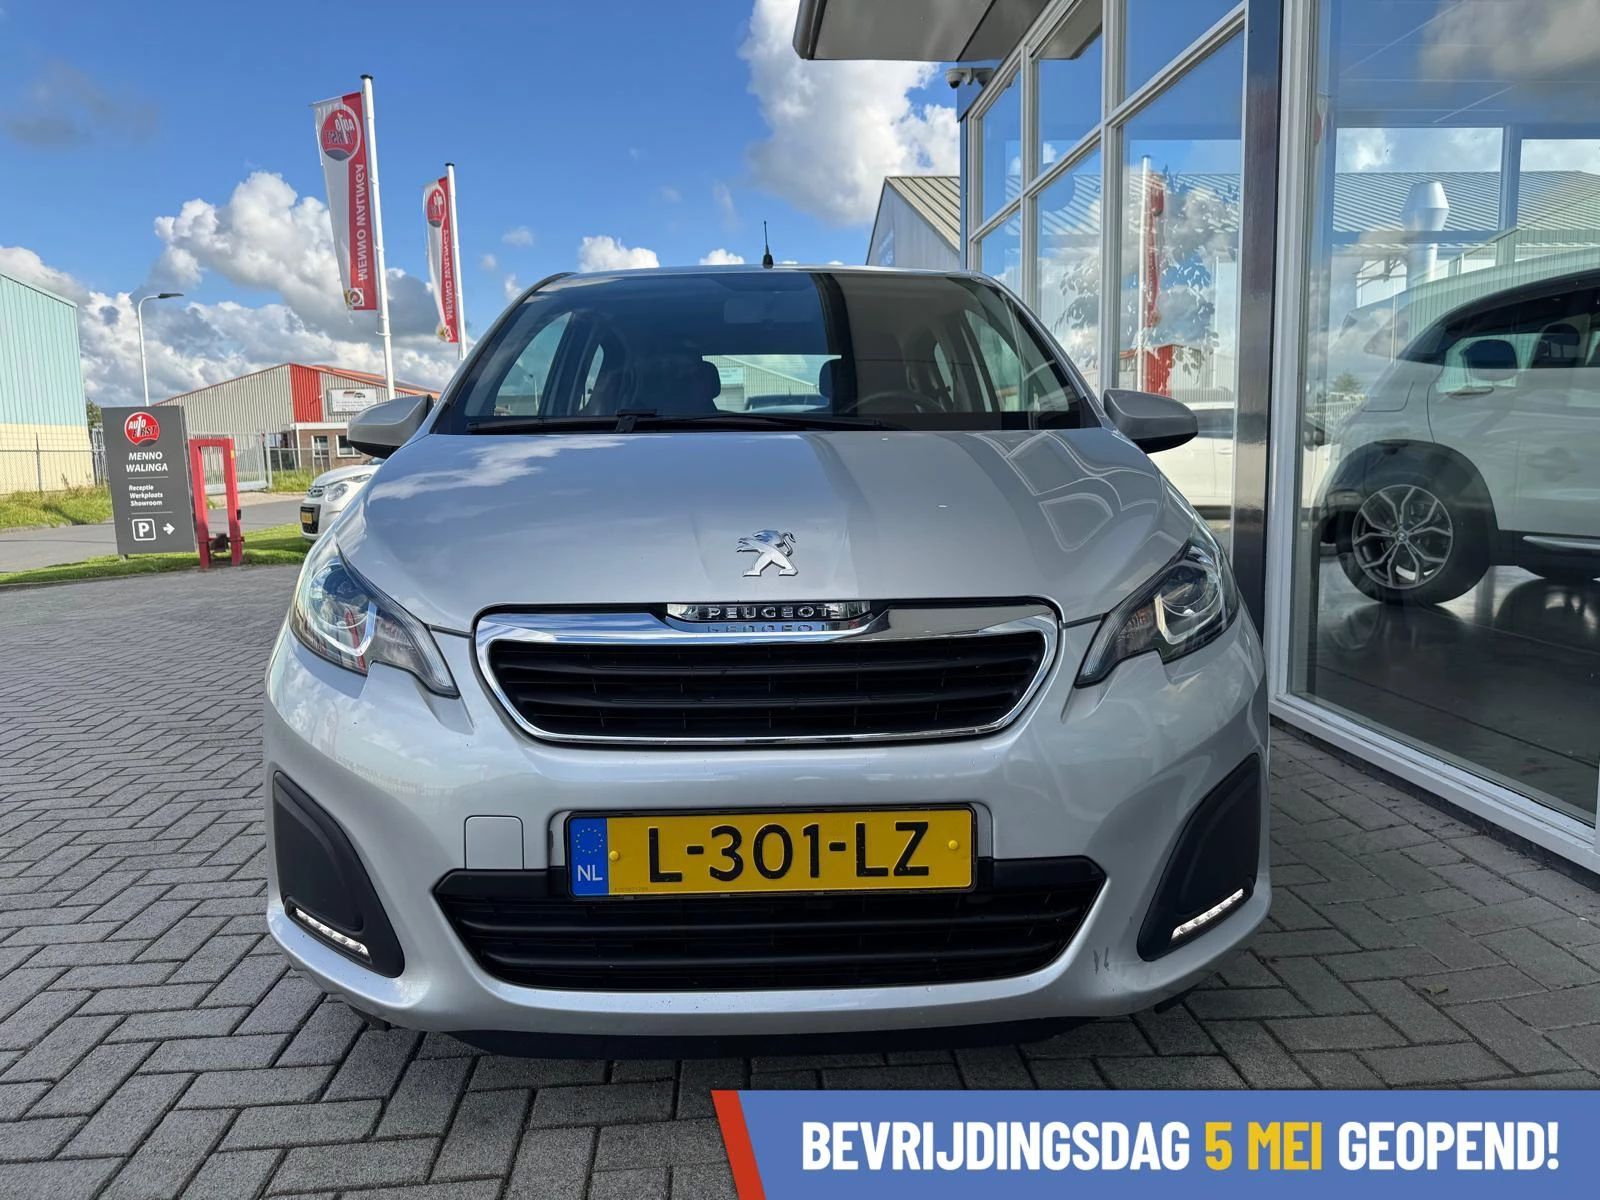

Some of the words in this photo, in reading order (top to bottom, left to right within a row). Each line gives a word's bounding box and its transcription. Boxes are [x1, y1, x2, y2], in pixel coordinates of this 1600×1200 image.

[128, 451, 163, 461] MENNO
[125, 462, 169, 473] WALINGA
[128, 484, 154, 492] Receptie
[129, 492, 163, 500] Werkplaats
[138, 522, 150, 537] P
[706, 606, 830, 619] PEUGEOT
[648, 821, 930, 883] L-301-LZ
[577, 864, 603, 881] NL
